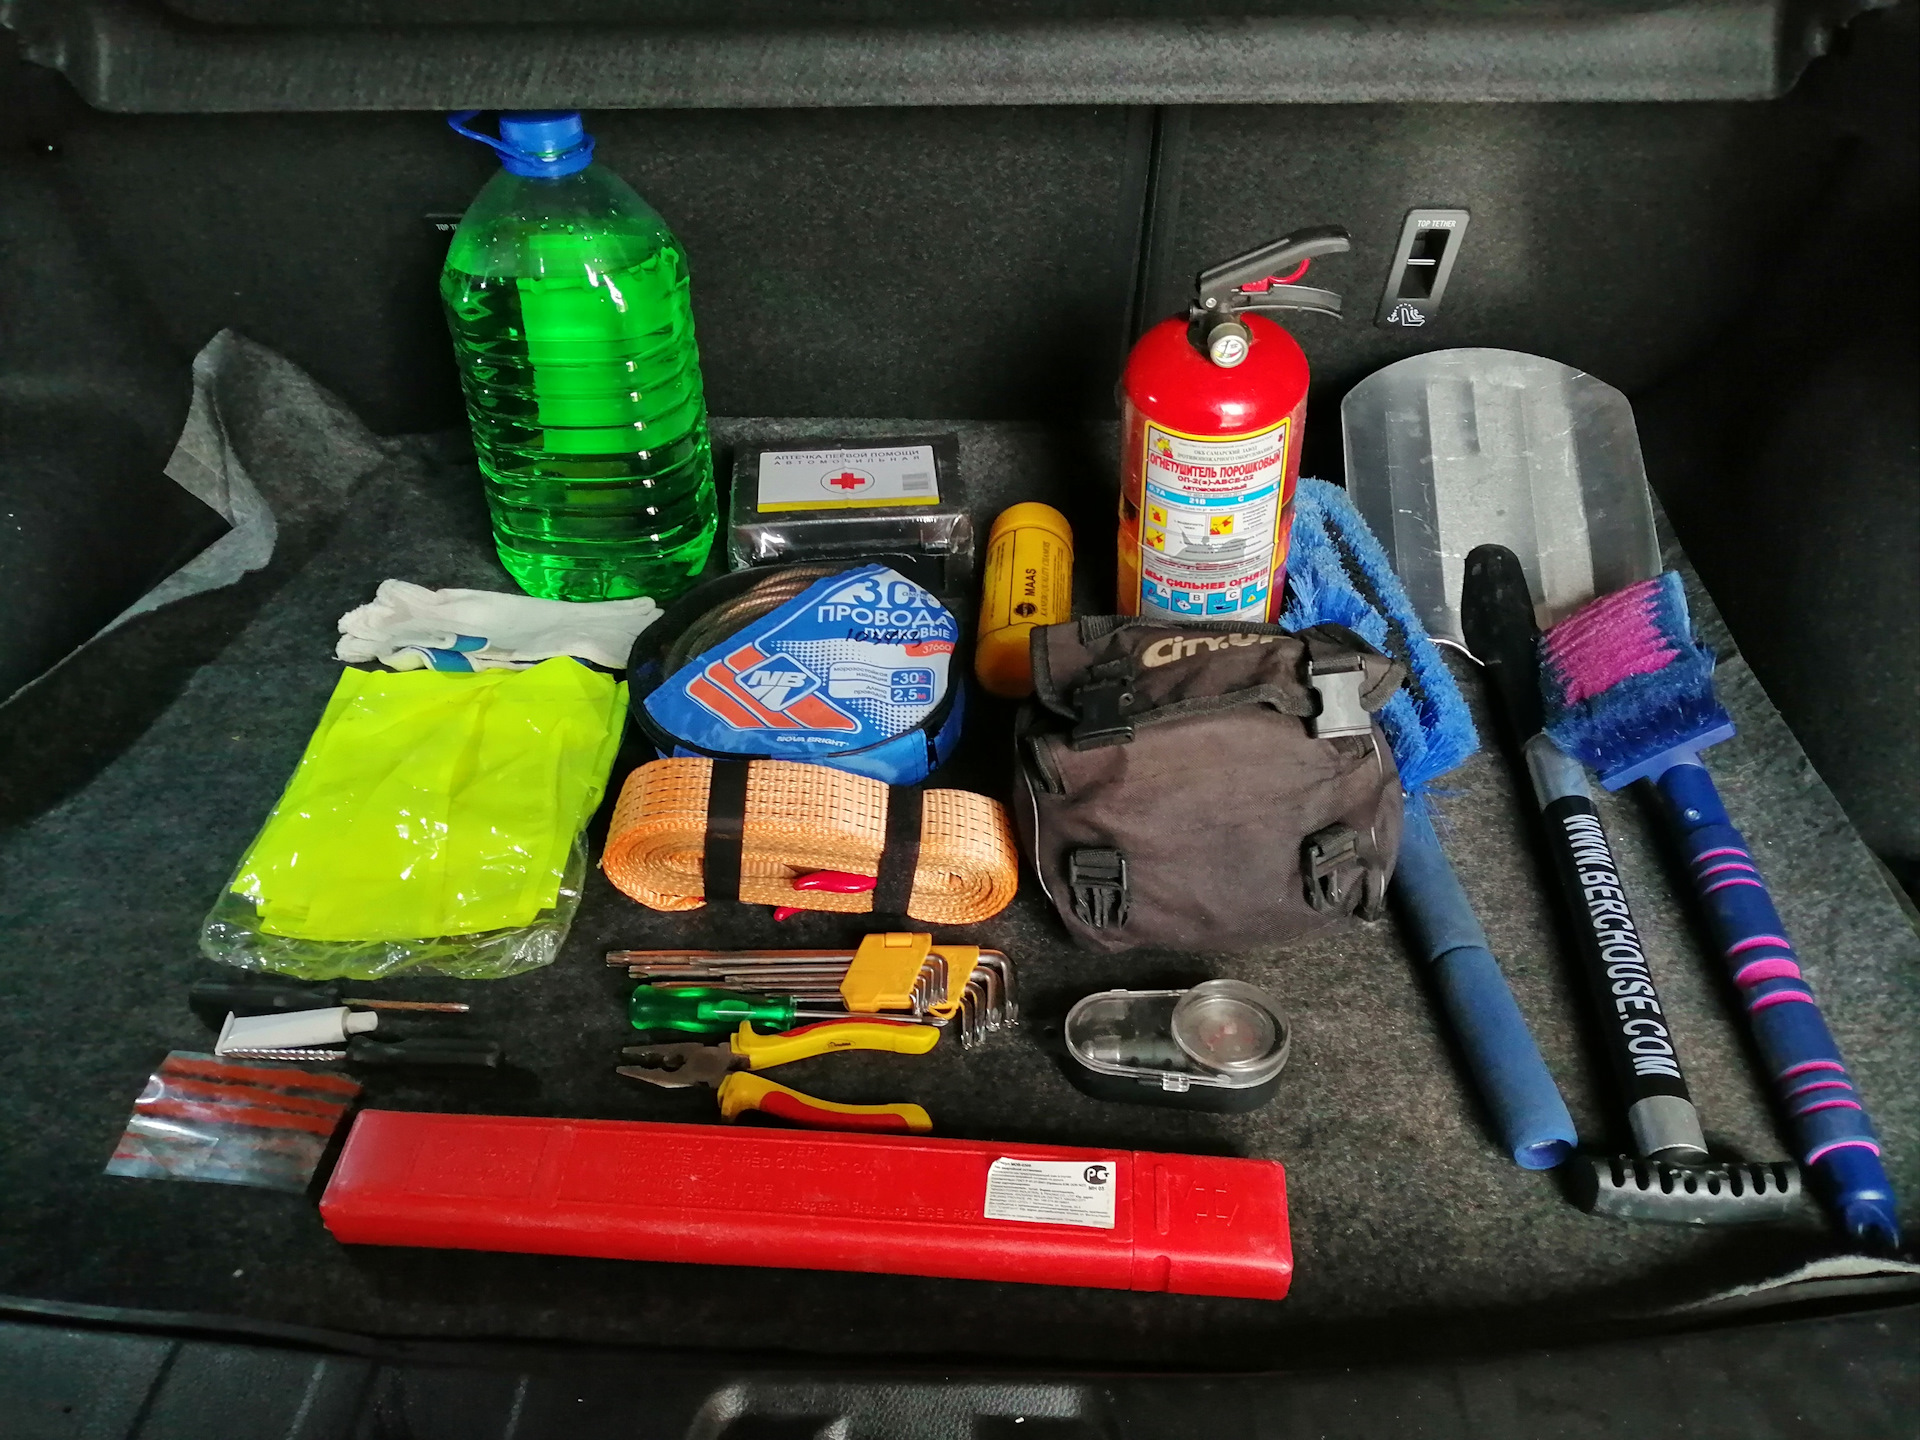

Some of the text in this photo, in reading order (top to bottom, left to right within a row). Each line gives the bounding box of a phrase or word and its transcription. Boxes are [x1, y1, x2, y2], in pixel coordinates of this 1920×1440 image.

[1417, 220, 1456, 228] TOP TETHER
[774, 450, 920, 461] АПТЕЧКА ПЕРВОЙ ПОМОЩИ
[1150, 452, 1217, 478] ОГНЕТУШИТЕЛЬ
[1024, 568, 1037, 597] MAAS
[1144, 567, 1164, 583] МЫ
[1166, 578, 1226, 591] СИЛЬНЕЕ
[1160, 587, 1169, 595] A
[1229, 591, 1237, 599] C
[818, 603, 953, 630] ПРОВОДА
[776, 735, 847, 748] NOVA BRIGHT
